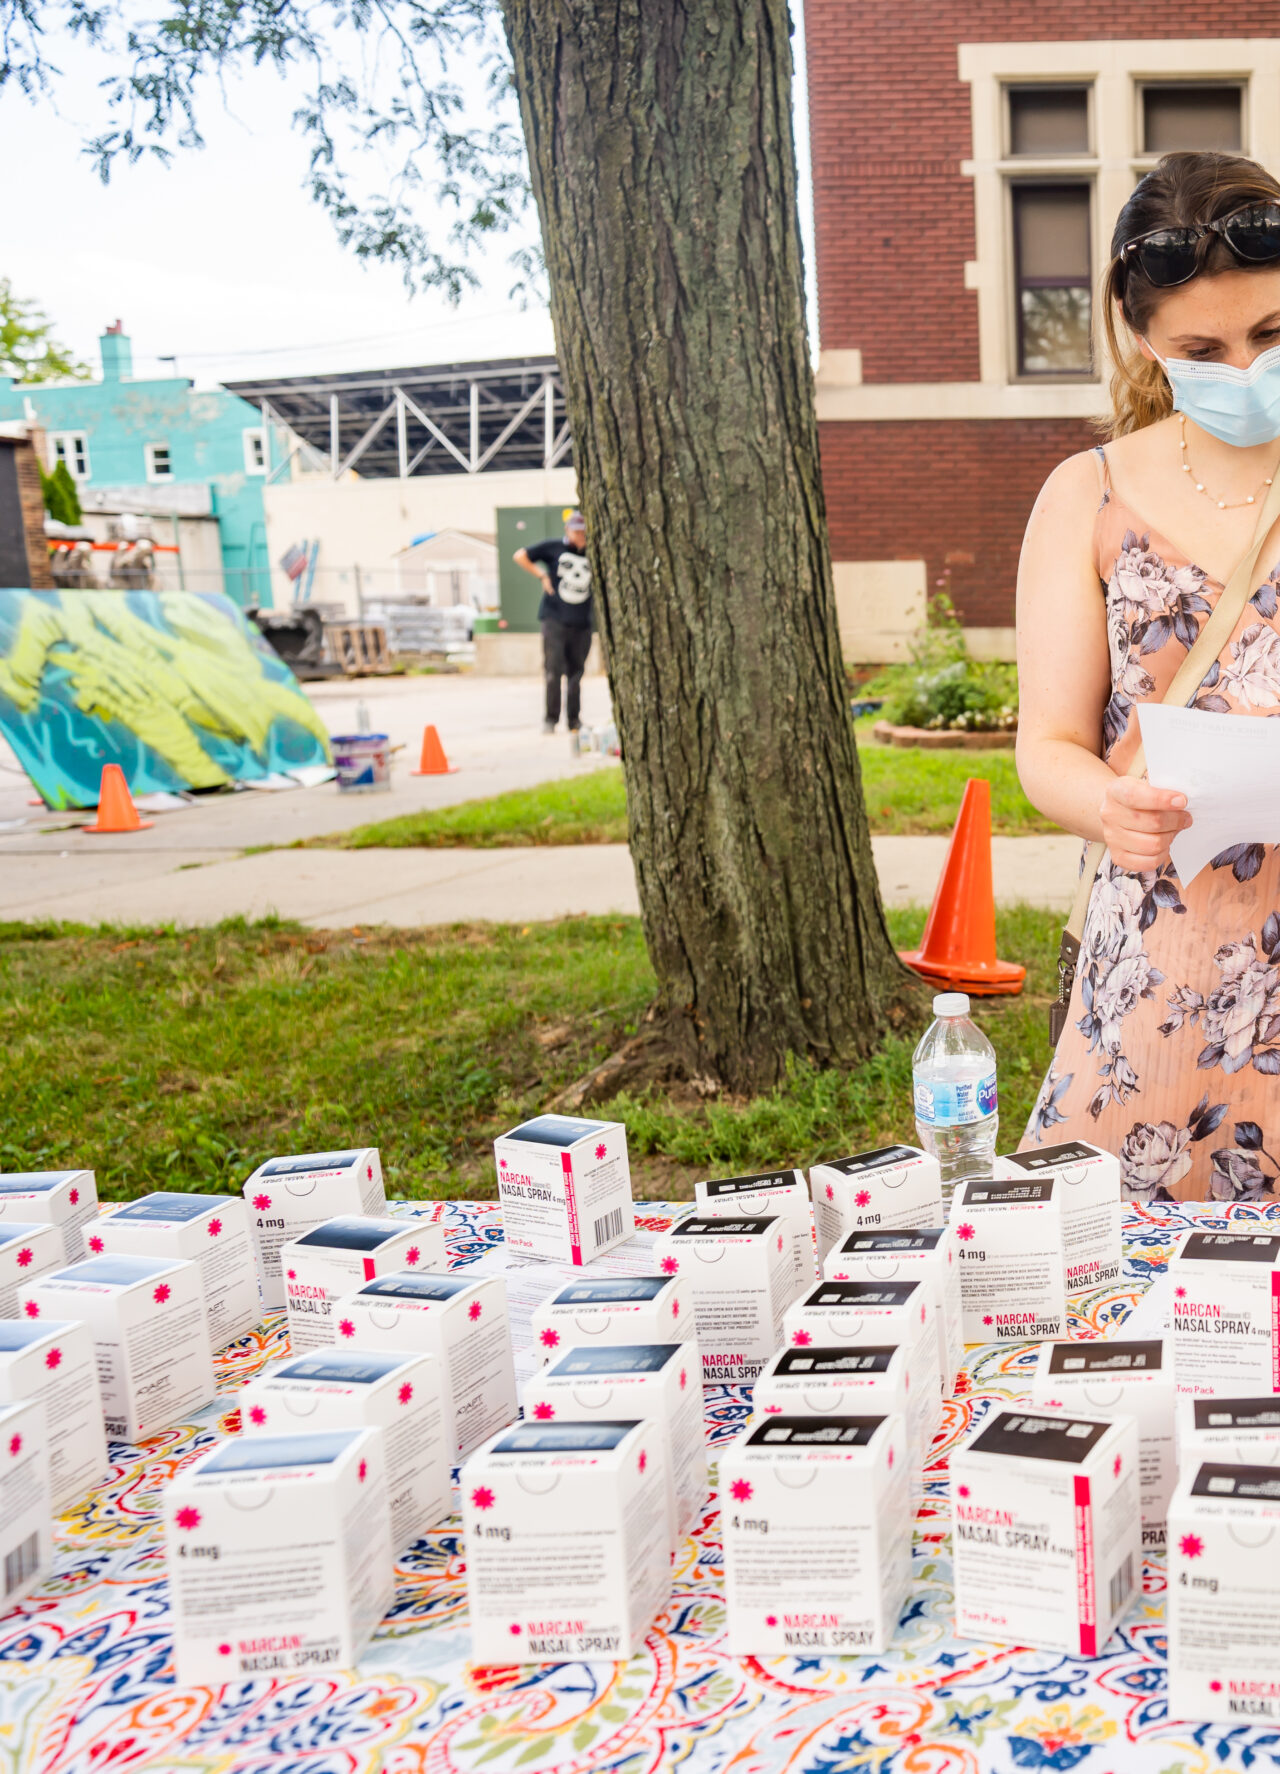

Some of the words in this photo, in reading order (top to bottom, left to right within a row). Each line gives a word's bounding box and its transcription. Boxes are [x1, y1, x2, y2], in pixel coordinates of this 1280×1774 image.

[500, 1171, 531, 1187] NARCAN
[501, 1183, 526, 1199] NASAL
[527, 1188, 551, 1202] SPRAY
[256, 1218, 264, 1228] 4
[265, 1218, 285, 1229] mg
[857, 1214, 864, 1226] 4
[865, 1213, 881, 1226] mg
[958, 1249, 966, 1260] 4
[967, 1250, 986, 1262] mg
[1067, 1261, 1101, 1278] NARCAN
[1067, 1274, 1093, 1290] NASAL
[1094, 1267, 1120, 1284] SPRAY
[288, 1283, 326, 1300] NARCAN
[289, 1298, 319, 1315] NASAL
[1174, 1302, 1221, 1318] NARCAN
[996, 1313, 1036, 1326] NARCAN
[997, 1325, 1028, 1338] NASAL
[1030, 1323, 1060, 1337] SPRAY
[1174, 1318, 1211, 1333] NASAL
[1214, 1320, 1251, 1335] SPRAY
[1257, 1329, 1271, 1338] mg
[702, 1354, 744, 1366] NARCAN
[703, 1367, 736, 1380] NASAL
[738, 1365, 765, 1378] SPRA
[1177, 1384, 1193, 1394] Two
[1194, 1384, 1215, 1395] Pack
[104, 1422, 128, 1437] PRAY
[957, 1504, 1013, 1526] NARCAN
[474, 1524, 482, 1538] 4
[486, 1526, 511, 1541] mg
[732, 1515, 739, 1529] 4
[744, 1518, 769, 1534] mg
[958, 1524, 999, 1546] NASAL
[1005, 1531, 1049, 1551] SPRAY
[1142, 1530, 1167, 1545] PRA
[178, 1545, 186, 1557] 4
[191, 1545, 220, 1559] mg
[1180, 1573, 1187, 1586] 4
[1192, 1577, 1219, 1593] mg
[528, 1621, 585, 1636] NARCAN
[784, 1614, 839, 1629] NARCAN
[529, 1639, 573, 1655] NASAL
[578, 1636, 620, 1653] SPRAY
[785, 1632, 827, 1647] NASAL
[833, 1631, 874, 1646] SPRAY
[240, 1653, 286, 1672] NASAL
[294, 1648, 339, 1666] SPRAY
[1229, 1699, 1274, 1717] NASAL
